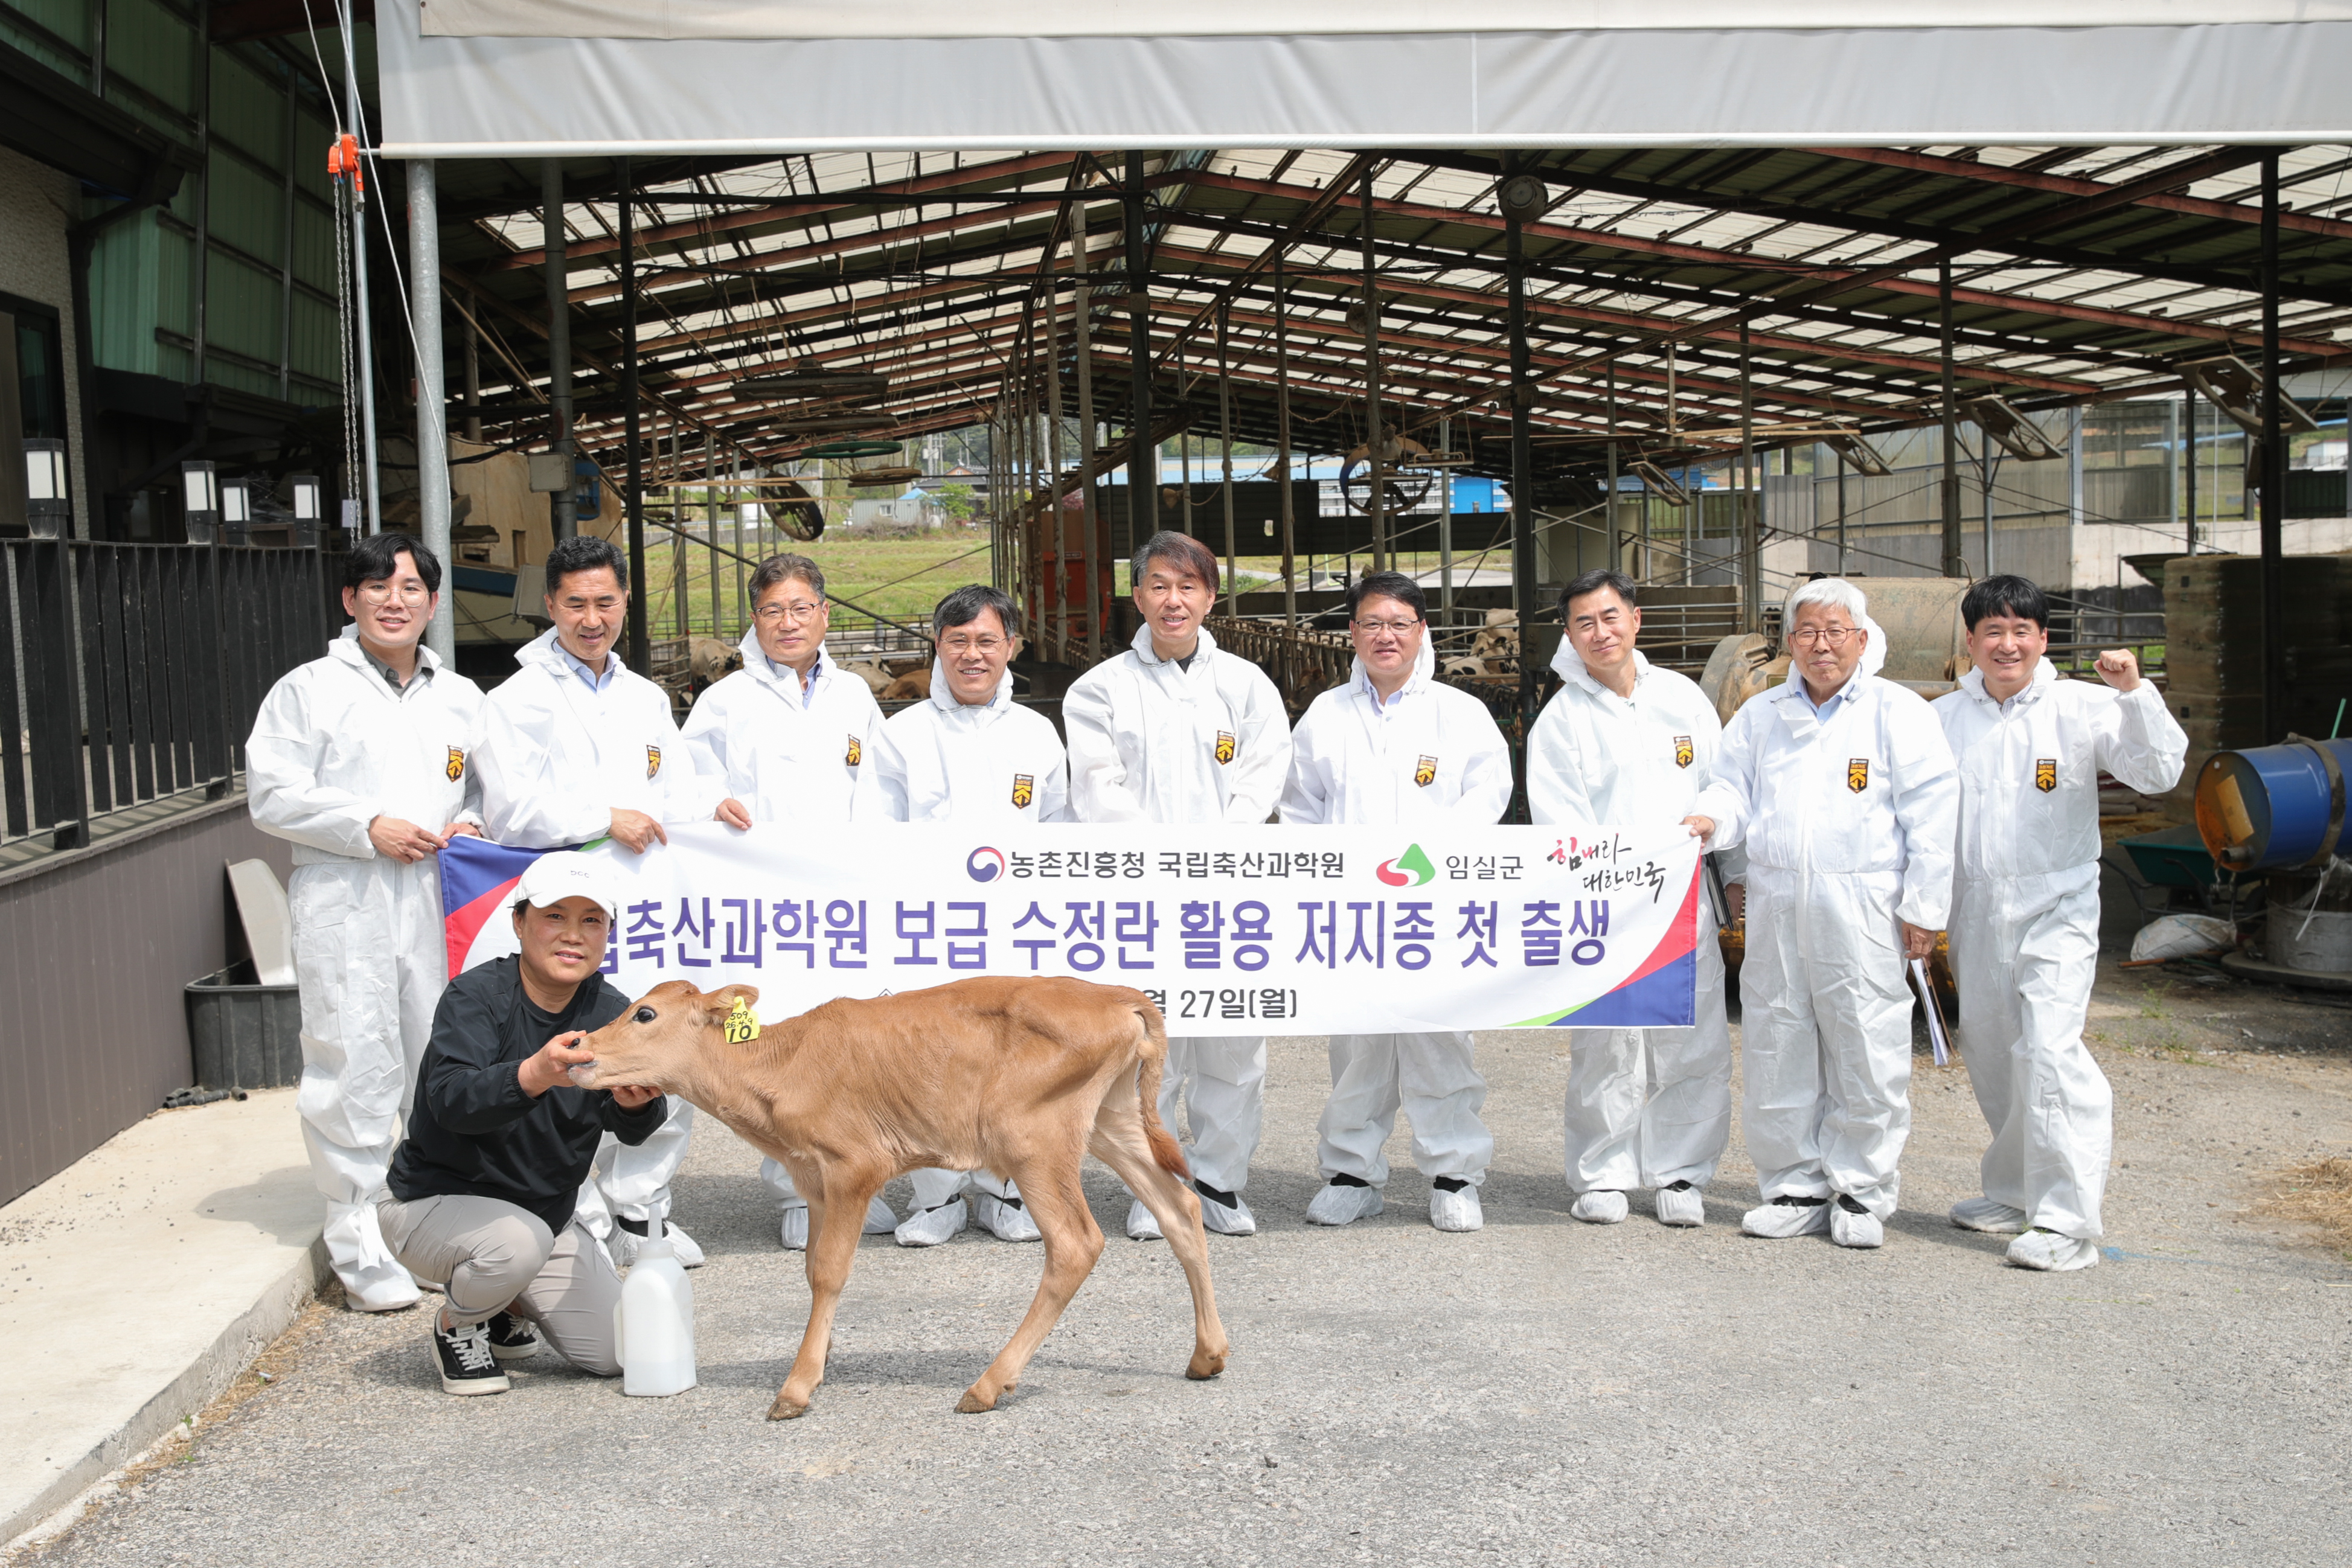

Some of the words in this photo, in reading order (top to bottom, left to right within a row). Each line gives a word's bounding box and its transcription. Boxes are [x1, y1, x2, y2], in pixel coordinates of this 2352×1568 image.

[1010, 851, 1145, 878] 농촌진흥청
[1158, 852, 1344, 878] 국립축산과학원
[1546, 832, 1632, 871] 힘내라
[1446, 856, 1524, 880] 임실군
[1582, 861, 1667, 904] 대한민국
[894, 900, 989, 970] 보급
[1012, 900, 1159, 972] 수정란
[1180, 900, 1273, 971] 활용
[1295, 900, 1435, 970] 저지종
[1456, 900, 1499, 968] 첫
[1520, 900, 1610, 967] 출생
[729, 1011, 748, 1020] 509
[1180, 988, 1297, 1019] 27일(월)
[728, 1025, 752, 1043] 10
